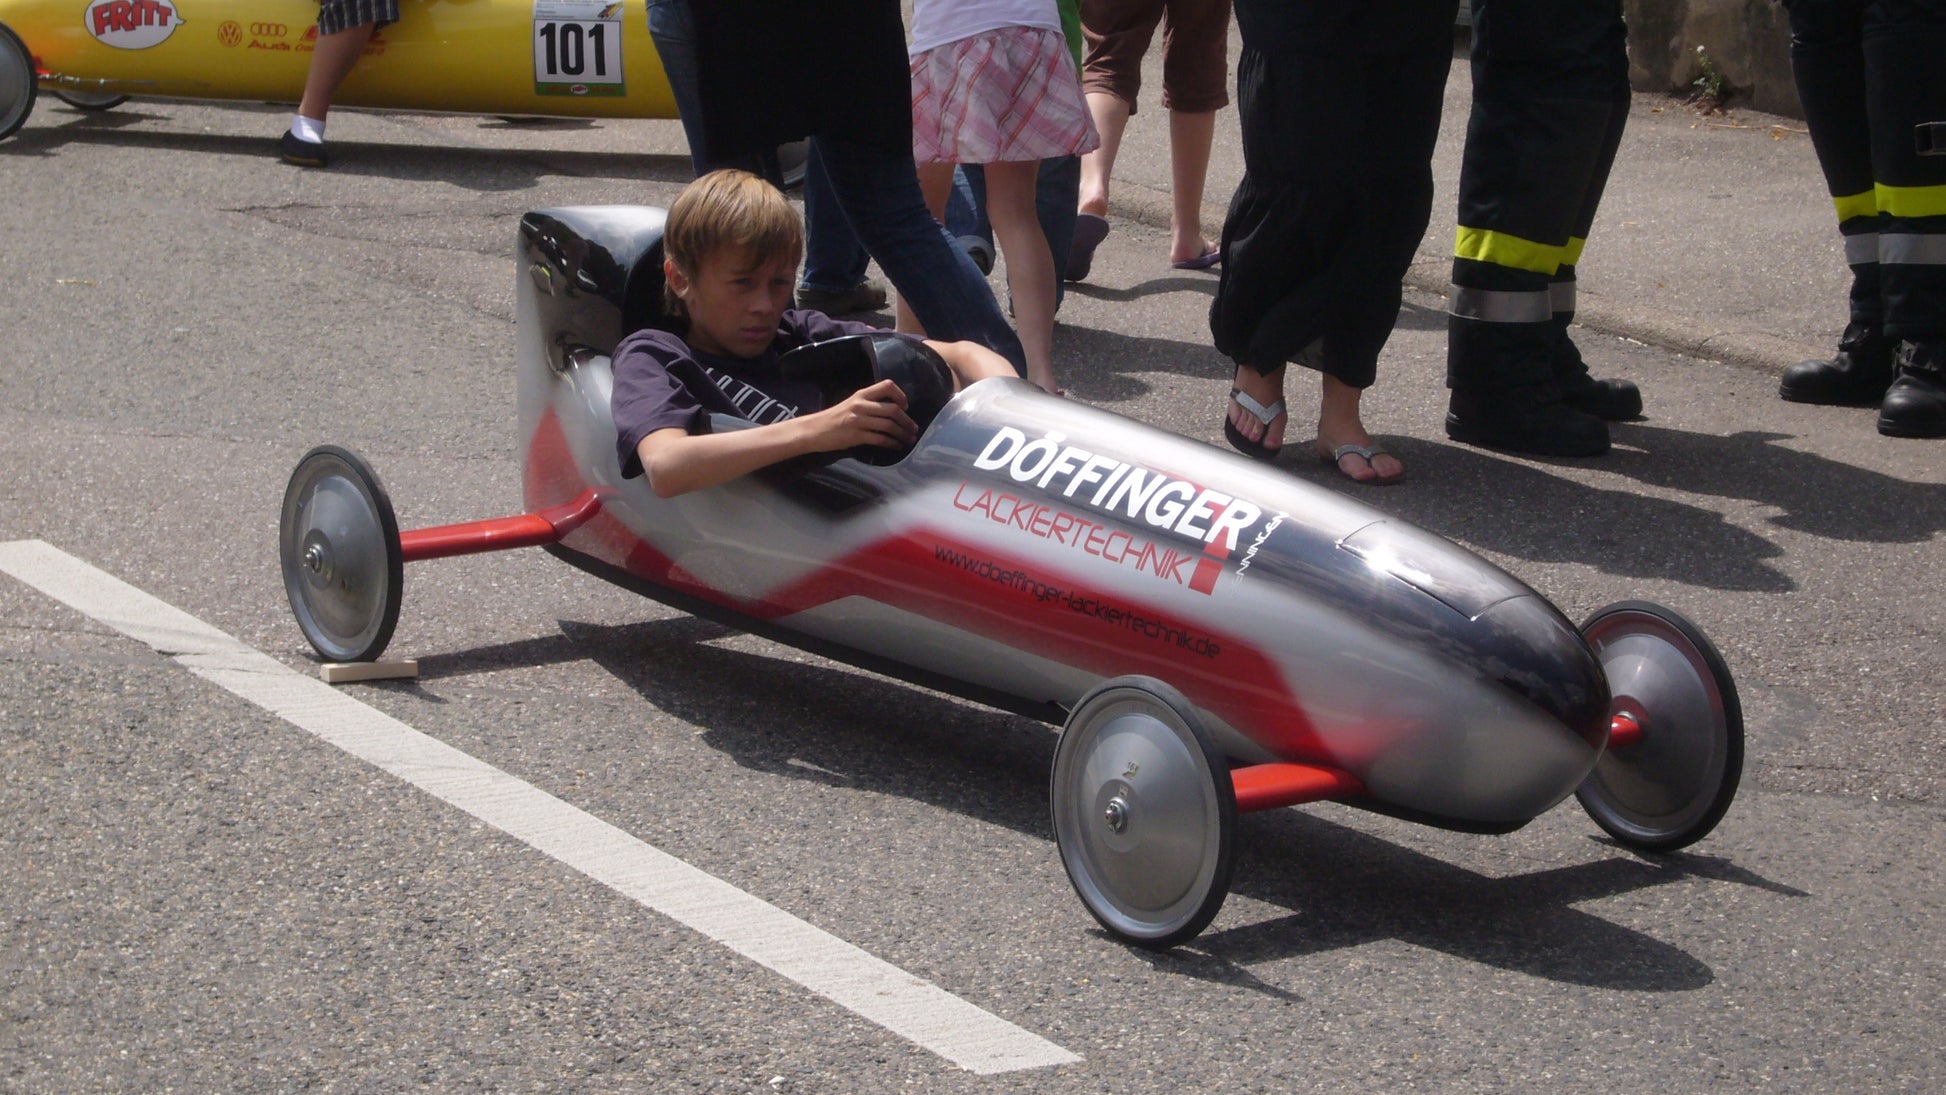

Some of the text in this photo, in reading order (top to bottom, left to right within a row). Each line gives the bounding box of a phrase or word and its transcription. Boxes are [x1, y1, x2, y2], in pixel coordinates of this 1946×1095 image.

[92, 0, 172, 36] FRITT
[540, 22, 606, 76] 101
[953, 481, 1193, 584] LACKIERTECHNIK
[973, 426, 1261, 551] DÖFFINGER
[1231, 511, 1289, 595] ENNINGEN
[935, 544, 1220, 659] www.doeffinger-lackiertechnik.de
